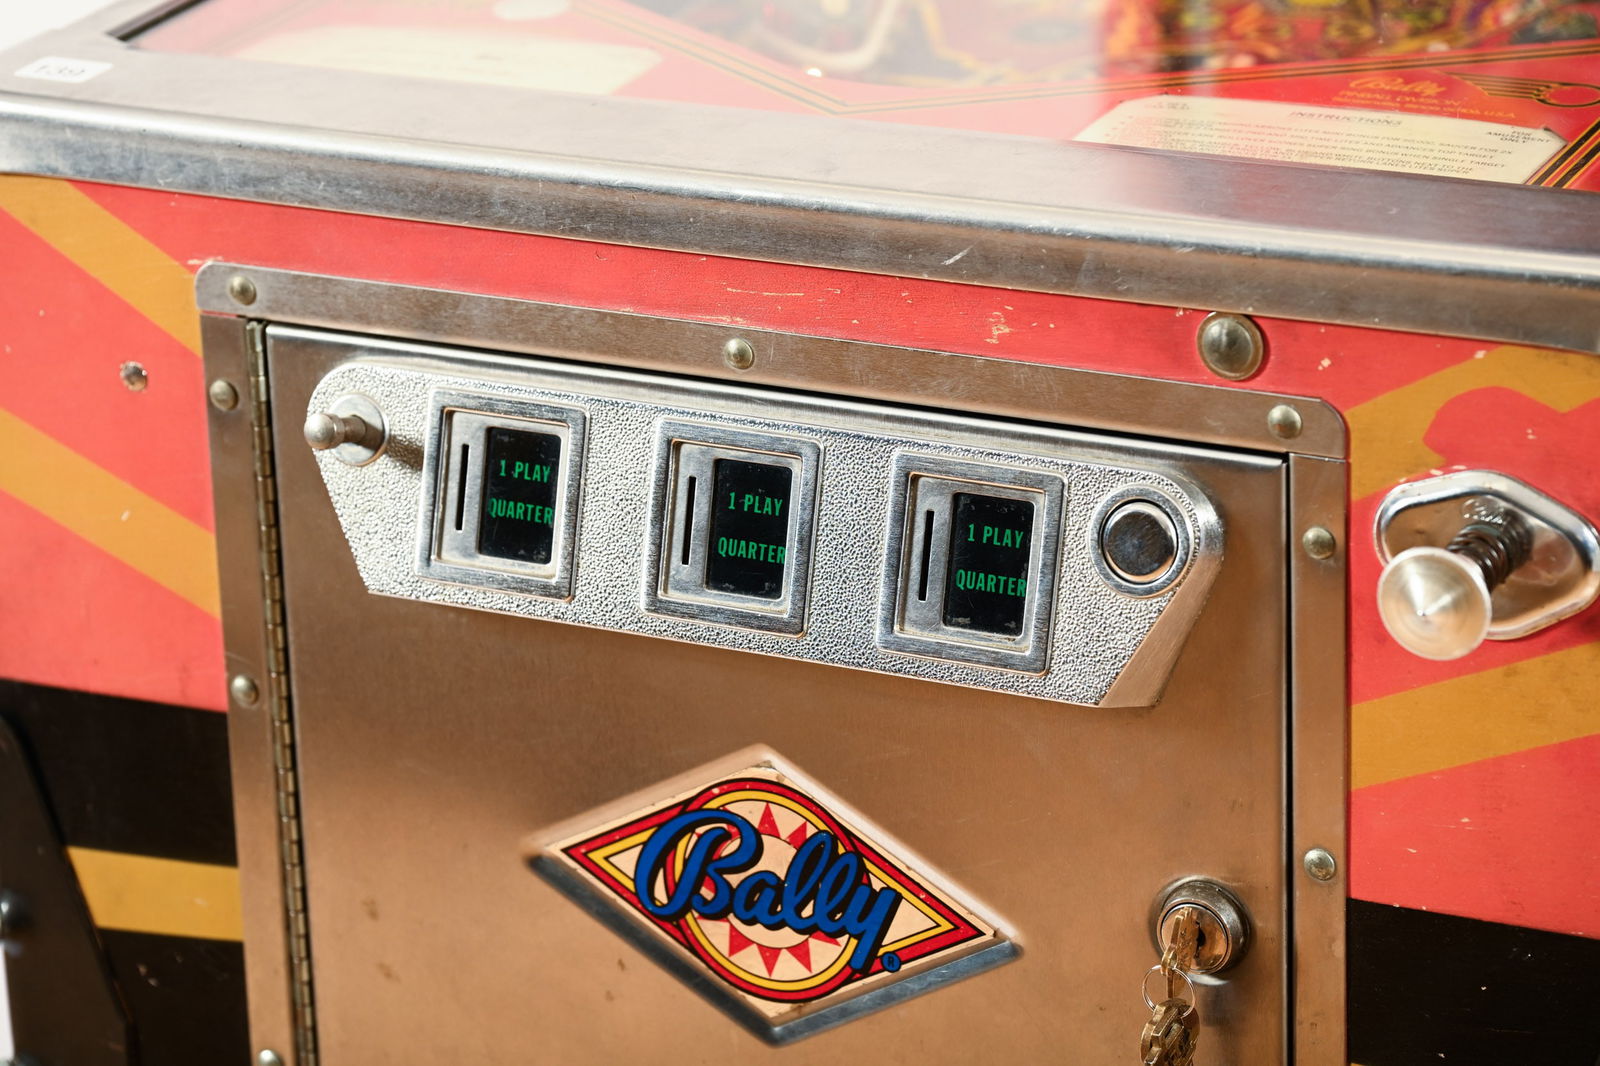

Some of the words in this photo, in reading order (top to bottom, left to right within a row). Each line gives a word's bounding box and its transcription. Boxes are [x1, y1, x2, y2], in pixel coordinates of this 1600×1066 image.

[1289, 110, 1402, 125] INSTRUCTIONS
[499, 459, 507, 477] 1
[513, 460, 551, 484] PLAY
[488, 497, 554, 526] QUARTER
[728, 491, 736, 510] 1
[743, 493, 783, 516] PLAY
[967, 523, 975, 542] 1
[982, 525, 1024, 549] PLAY
[717, 536, 787, 565] QUARTER
[955, 568, 1027, 597] QUARTER
[634, 808, 903, 974] Bally
